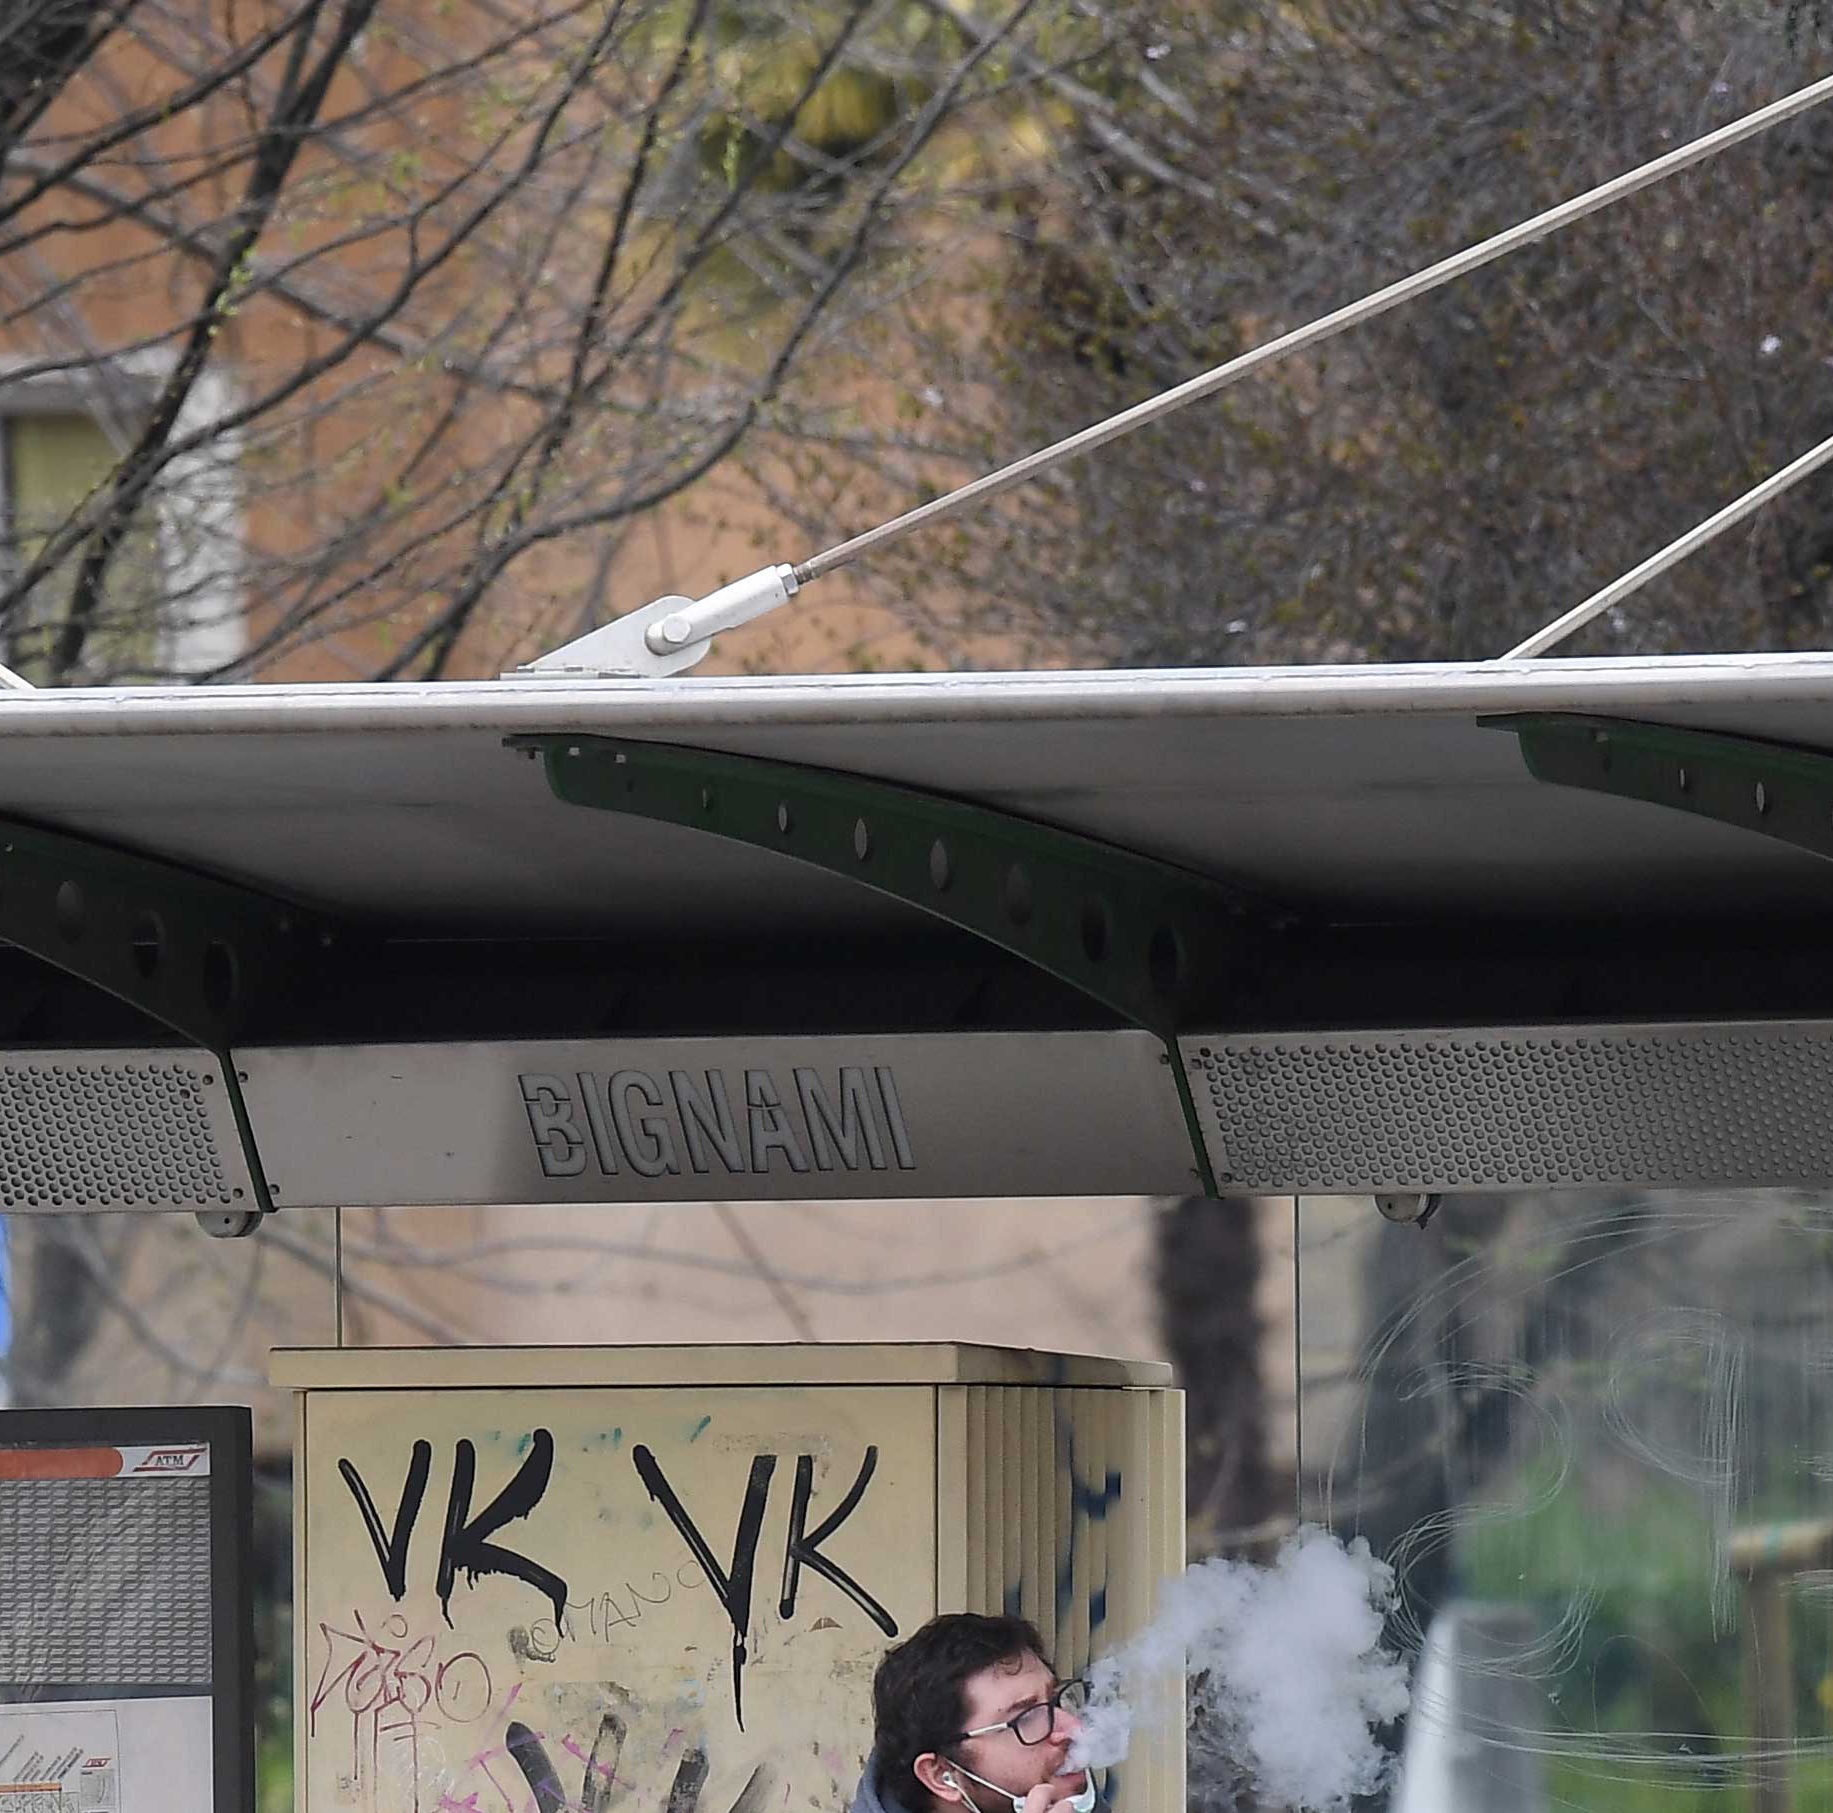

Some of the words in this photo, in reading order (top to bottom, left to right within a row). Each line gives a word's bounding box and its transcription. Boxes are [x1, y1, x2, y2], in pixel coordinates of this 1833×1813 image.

[517, 1066, 917, 1178] BIGNAMI
[337, 1428, 568, 1638] VK
[632, 1444, 899, 1650] VK
